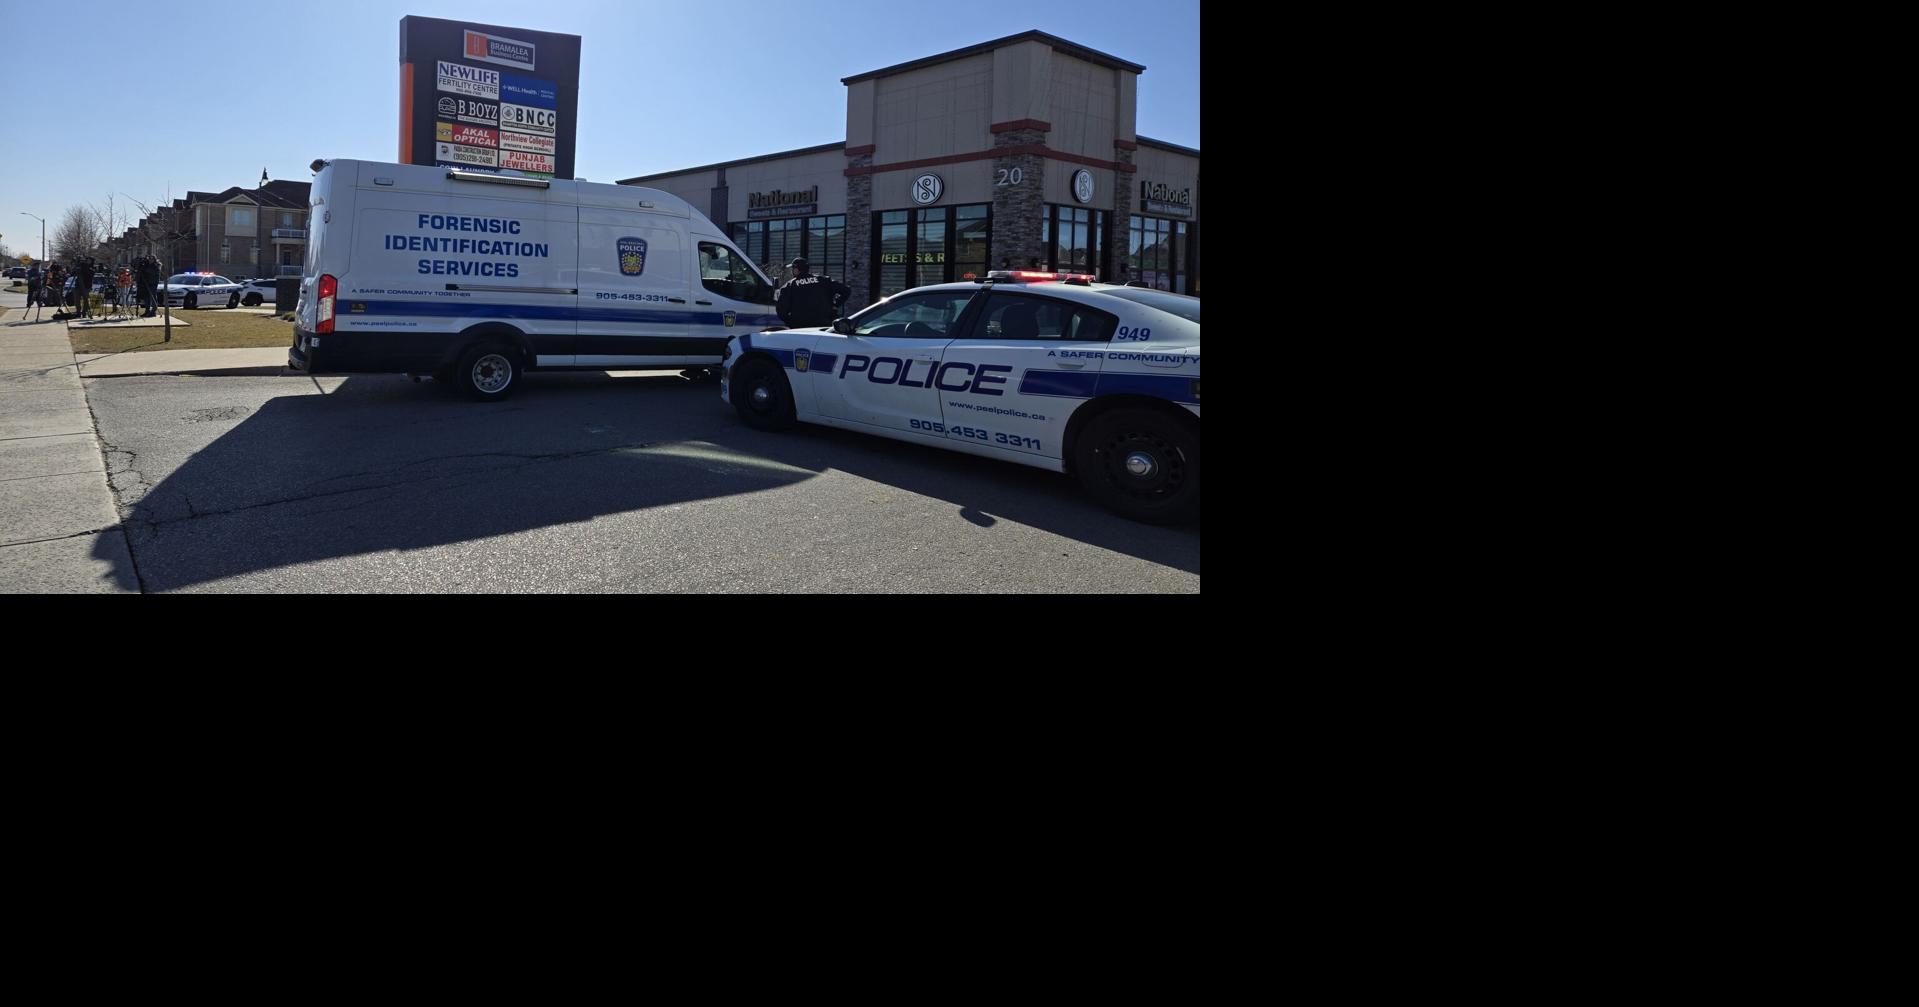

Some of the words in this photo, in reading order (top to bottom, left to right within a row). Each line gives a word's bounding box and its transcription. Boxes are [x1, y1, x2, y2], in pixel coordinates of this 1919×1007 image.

[490, 41, 529, 56] BRAMALEA
[439, 62, 498, 84] NEWLIFE
[439, 78, 471, 90] FERTILITY
[472, 83, 498, 95] CENTRE
[458, 99, 466, 114] B
[469, 101, 498, 120] BOYZ
[515, 107, 555, 127] BNCC
[453, 134, 497, 147] OPTICAL
[462, 127, 490, 138] AKAL
[501, 132, 528, 143] Northview
[528, 135, 554, 148] Collegiate
[500, 160, 554, 172] JEWELLERS
[509, 152, 545, 164] PUNJAB
[997, 167, 1022, 187] 20
[418, 213, 521, 235] FORENSIC
[385, 234, 549, 258] IDENTIFICATION
[418, 259, 519, 278] SERVICES
[795, 276, 820, 287] POLICE
[203, 288, 228, 296] POLICE
[595, 292, 669, 303] 905-453-3311
[1117, 326, 1151, 341] 949
[1047, 350, 1057, 358] A
[1060, 351, 1105, 360] SAFER
[1107, 352, 1200, 364] COMMUNITY
[839, 354, 1013, 396] POLICE
[949, 401, 1046, 421] www.peelpolice.ca
[995, 432, 1042, 450] 3311
